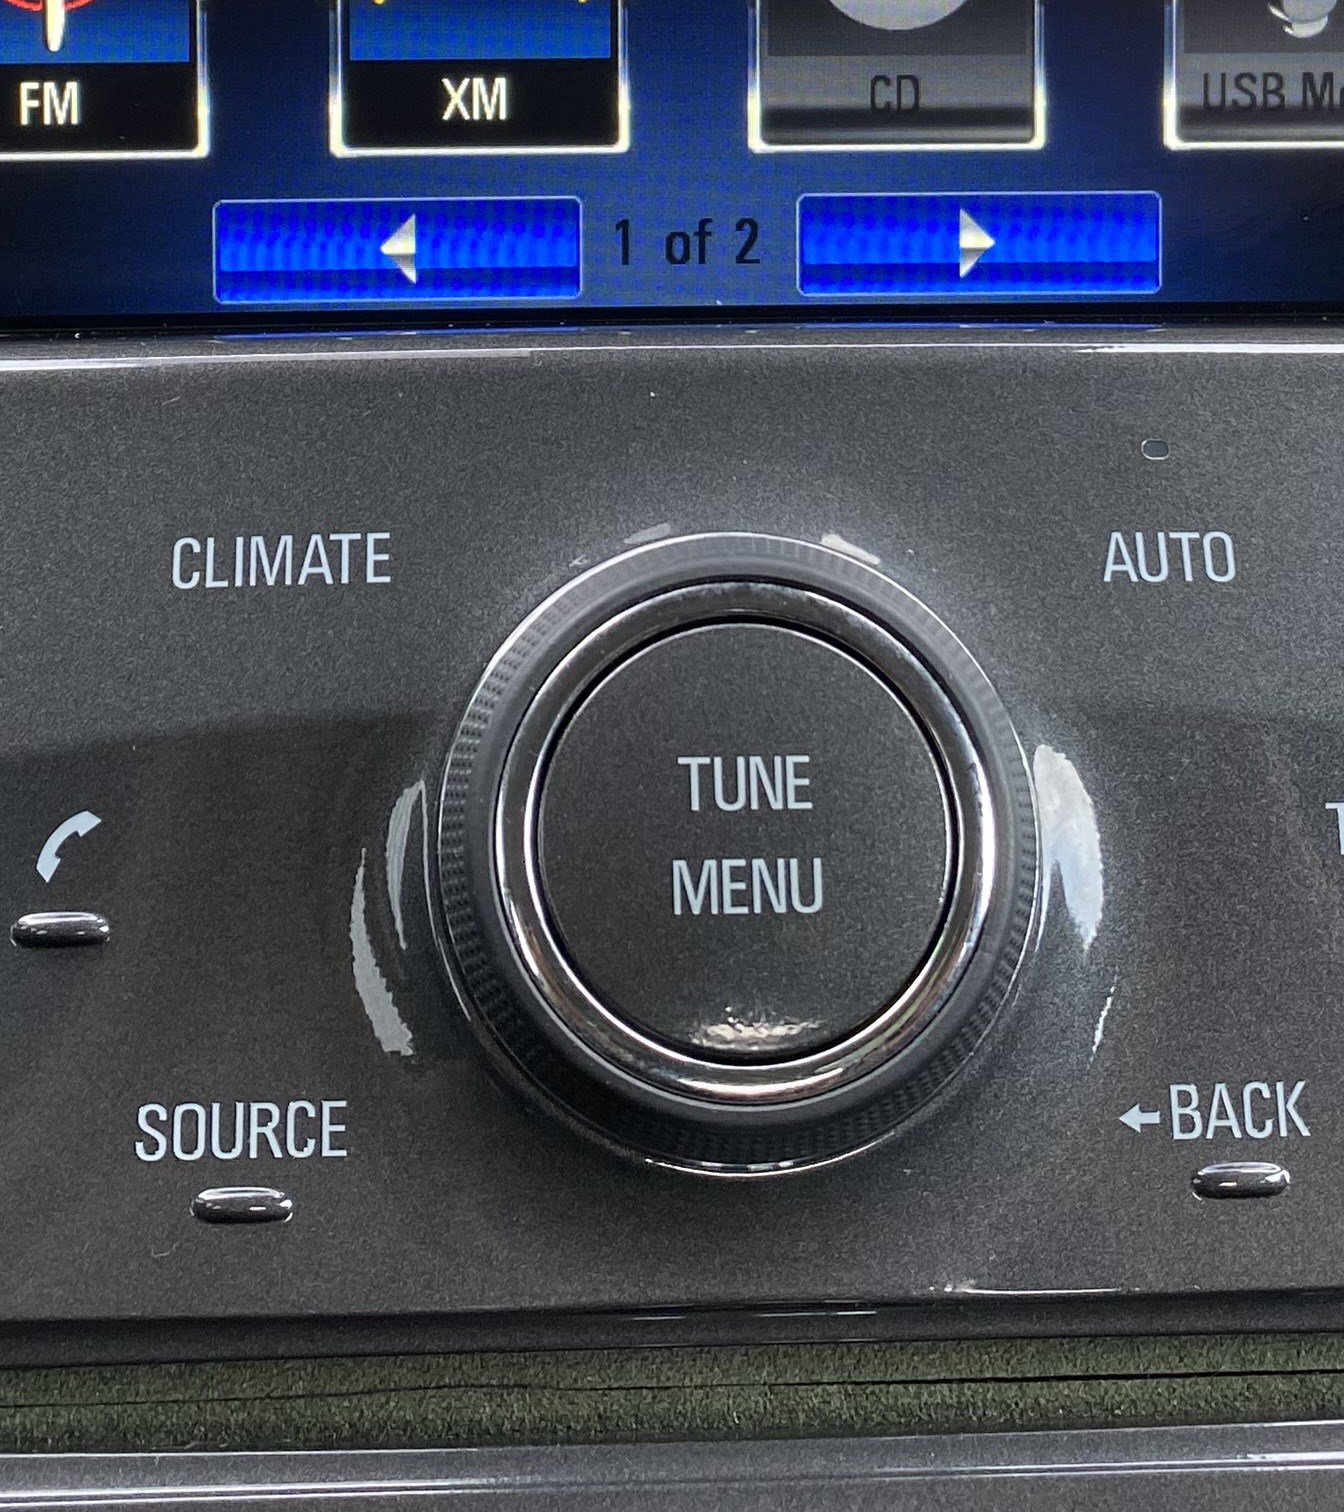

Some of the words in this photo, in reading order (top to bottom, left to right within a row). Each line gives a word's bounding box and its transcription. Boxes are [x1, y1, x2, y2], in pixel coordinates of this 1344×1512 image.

[18, 80, 81, 127] FM
[441, 75, 509, 122] XM
[869, 75, 921, 117] CD
[1201, 72, 1287, 113] USB
[614, 218, 631, 266] 1
[665, 217, 715, 266] of
[733, 218, 762, 266] 2
[171, 531, 392, 589] CLIMATE
[1103, 530, 1237, 584] AUTO
[677, 754, 813, 812] TUNE
[672, 858, 824, 916] MENU
[133, 1100, 348, 1161] SOURCE
[1169, 1080, 1311, 1140] BACK
